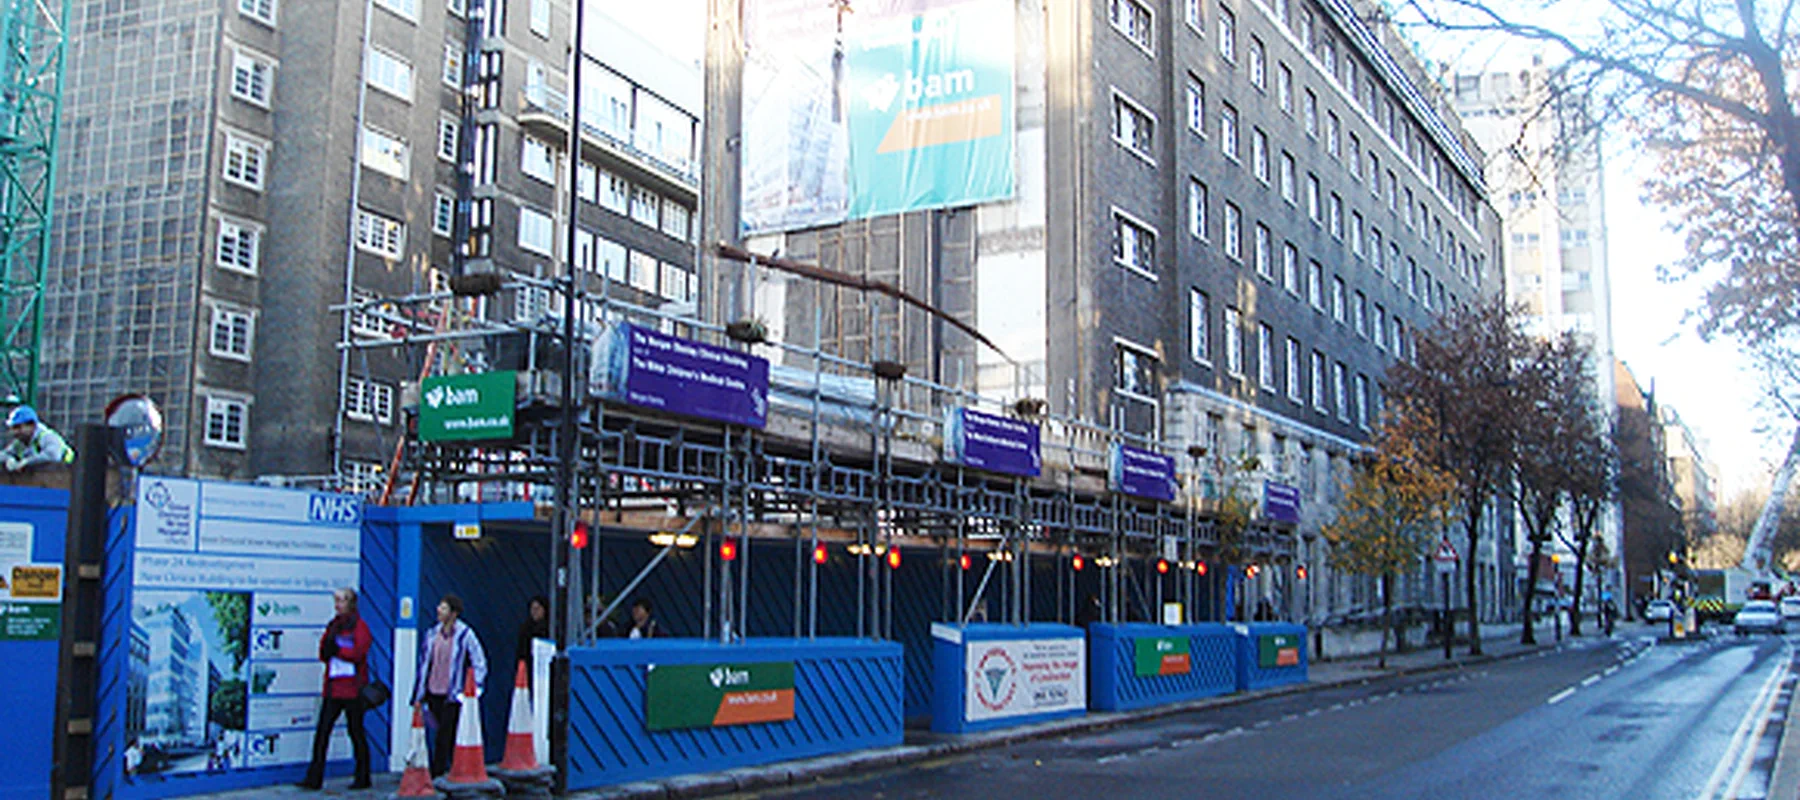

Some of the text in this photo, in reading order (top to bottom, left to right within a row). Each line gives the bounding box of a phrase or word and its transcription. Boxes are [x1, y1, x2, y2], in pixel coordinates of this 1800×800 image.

[904, 68, 973, 100] bam
[446, 385, 478, 405] bam
[312, 496, 357, 521] NHS
